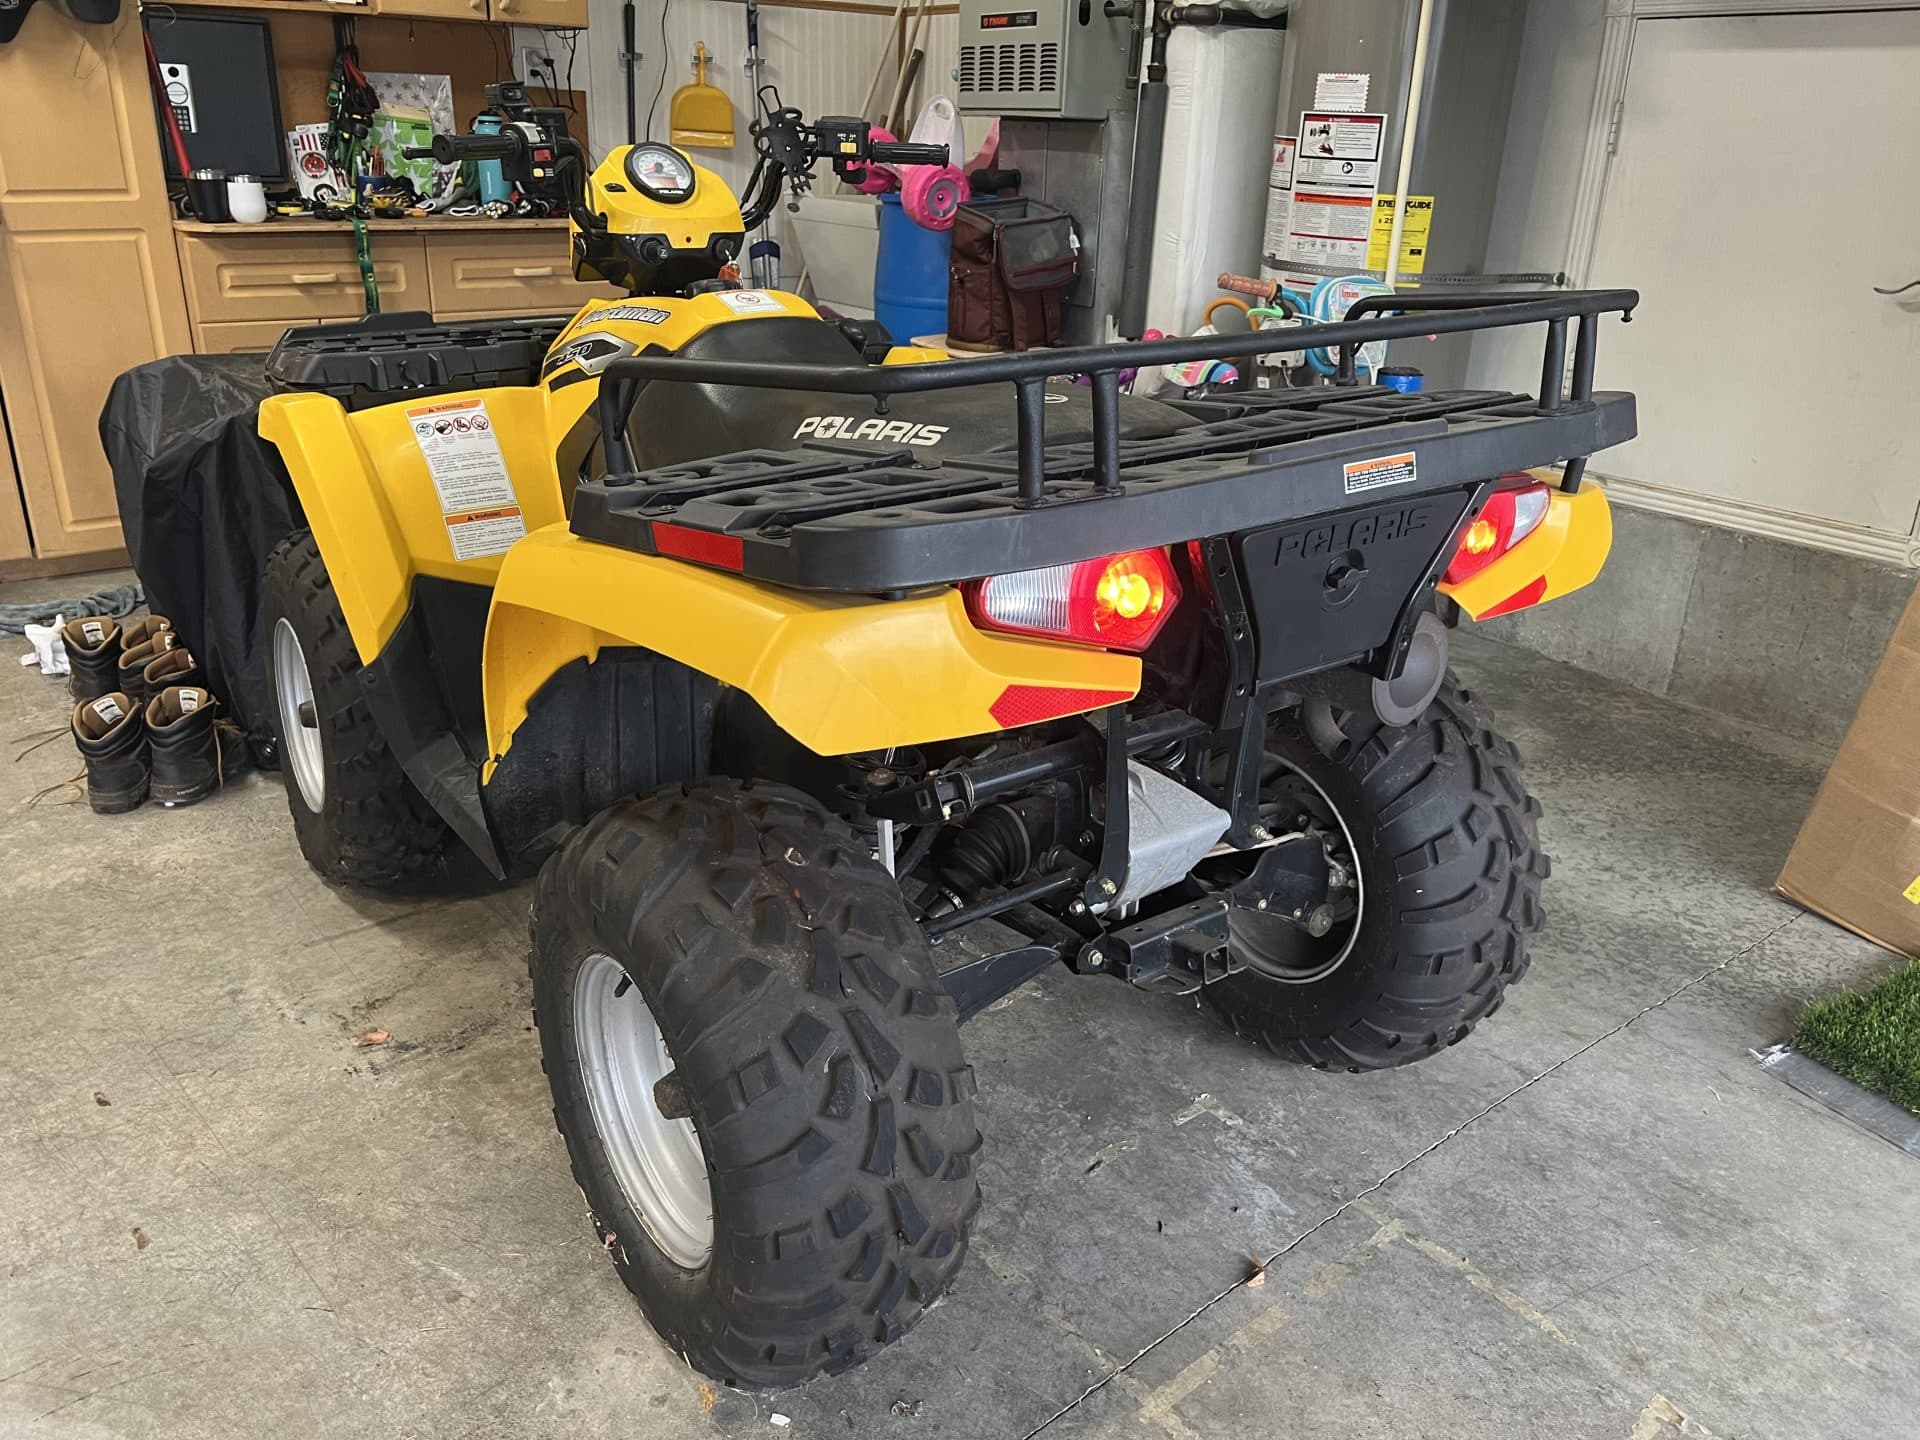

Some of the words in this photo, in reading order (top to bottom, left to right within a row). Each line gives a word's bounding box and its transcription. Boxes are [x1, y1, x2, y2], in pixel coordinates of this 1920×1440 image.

[792, 416, 950, 447] POLARIS
[474, 511, 502, 520] WARNING
[1274, 505, 1433, 567] POLARIS
